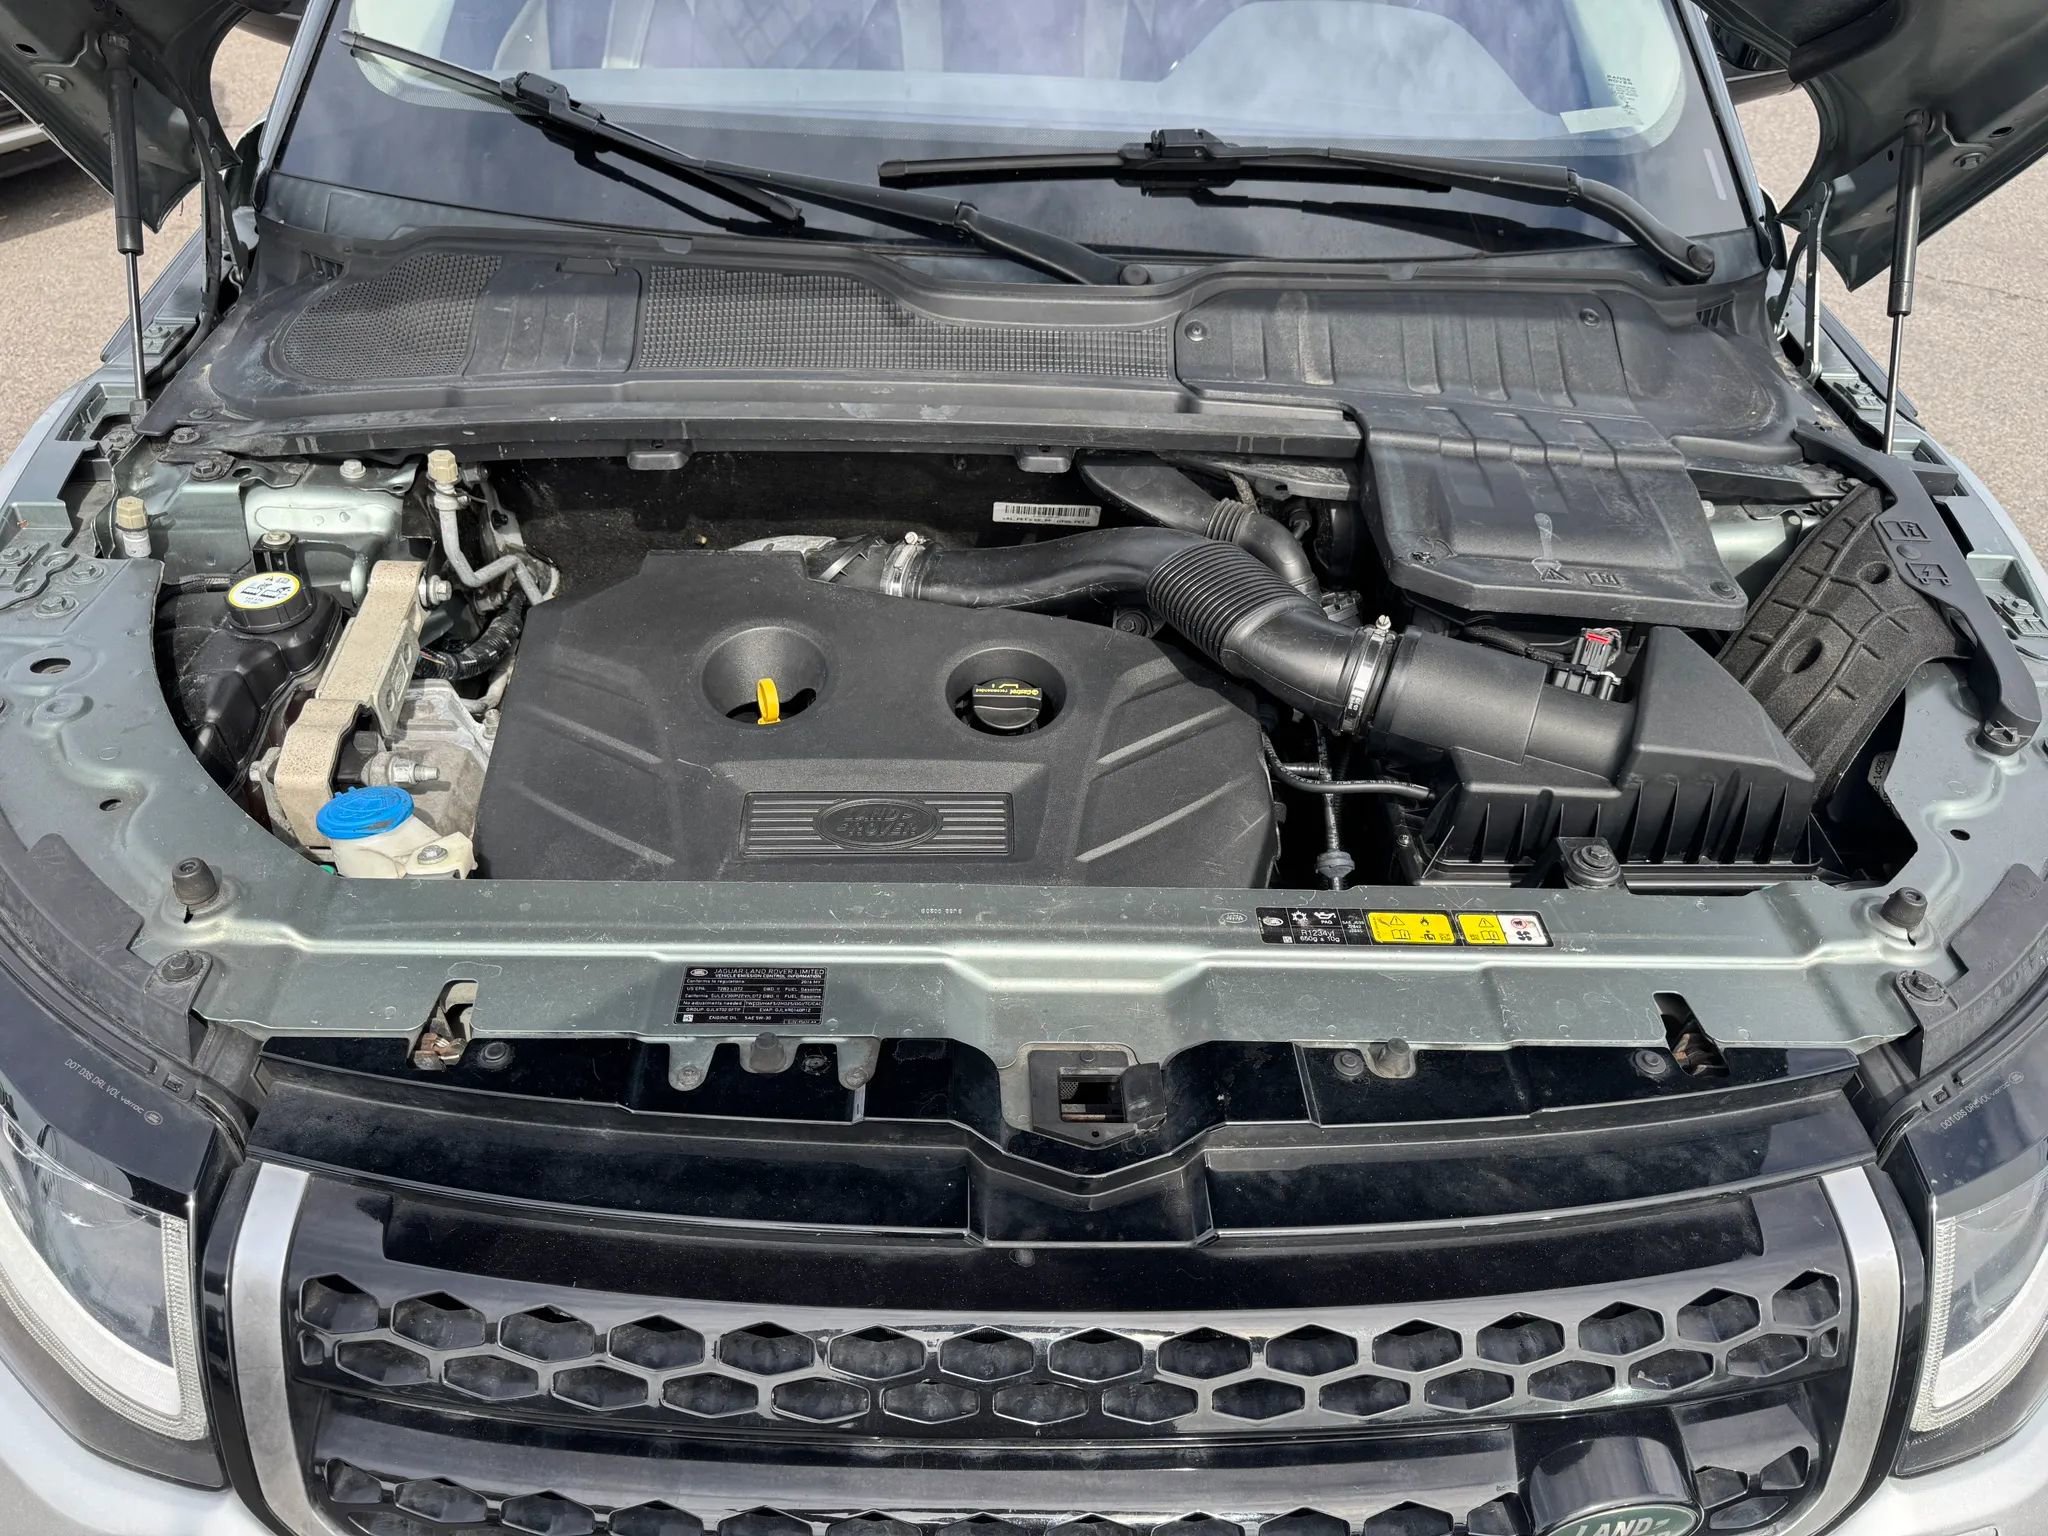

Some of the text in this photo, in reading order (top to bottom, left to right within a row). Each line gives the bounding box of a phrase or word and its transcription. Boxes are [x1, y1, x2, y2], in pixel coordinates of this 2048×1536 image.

[1301, 929, 1335, 937] R1234yf
[64, 1058, 82, 1073] DOT
[78, 1066, 93, 1080] D3S
[91, 1075, 106, 1090] DRL
[105, 1084, 120, 1099] VOL
[1940, 1116, 1957, 1130] DOT
[1574, 1516, 1654, 1536] LAND
